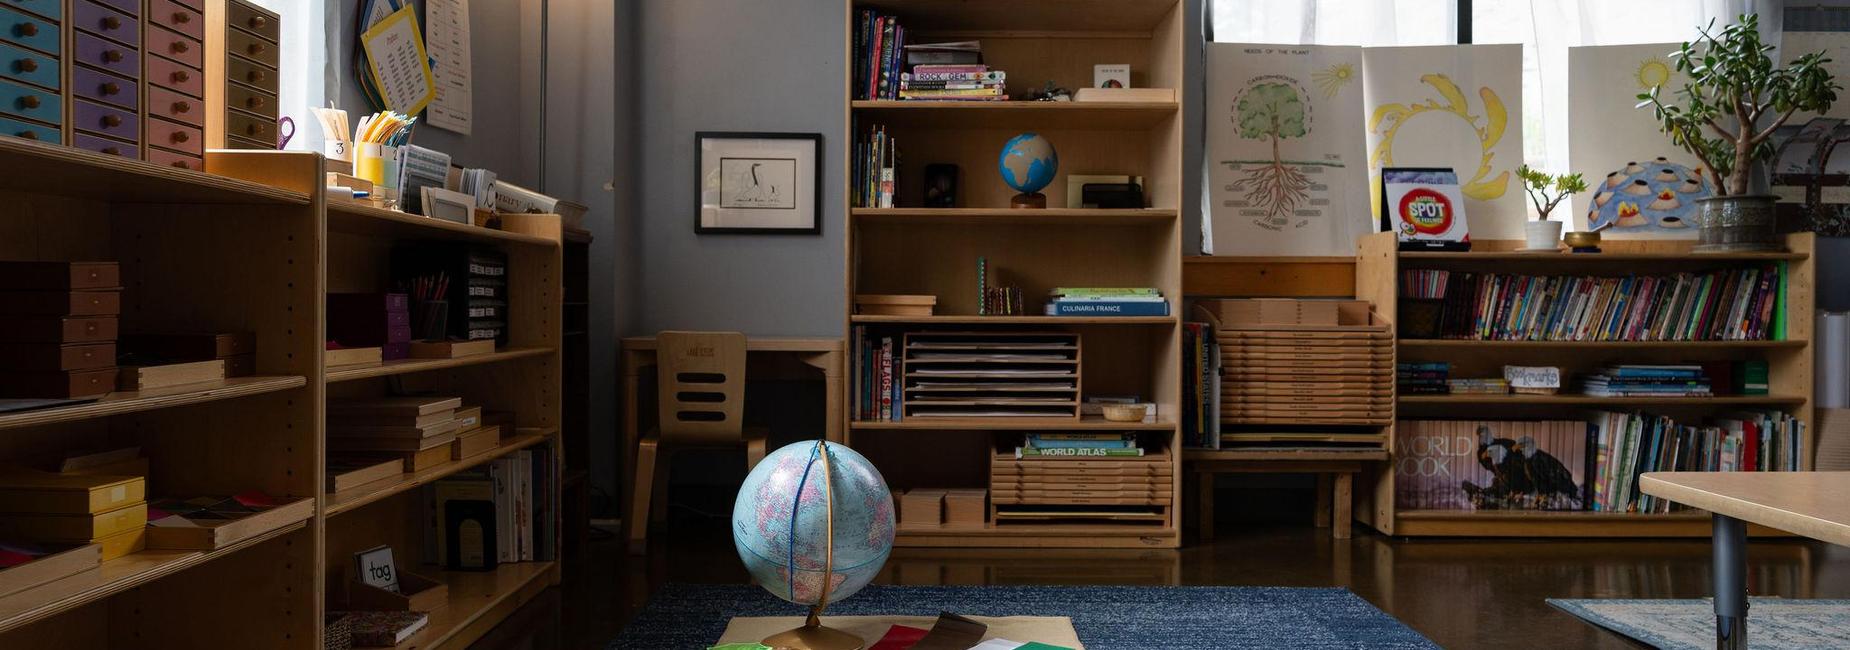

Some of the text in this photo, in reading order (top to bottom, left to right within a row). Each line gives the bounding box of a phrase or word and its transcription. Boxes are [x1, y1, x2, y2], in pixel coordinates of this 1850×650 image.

[919, 73, 967, 81] ROCK GEM
[336, 142, 344, 155] 3
[379, 145, 383, 156] 1
[393, 149, 398, 161] 2
[1408, 202, 1445, 218] SPOT
[1062, 305, 1121, 313] CULINARIA FRANCE
[881, 359, 891, 391] FLAGS
[1040, 448, 1107, 456] WORLD ATLAS
[369, 561, 392, 581] tag
